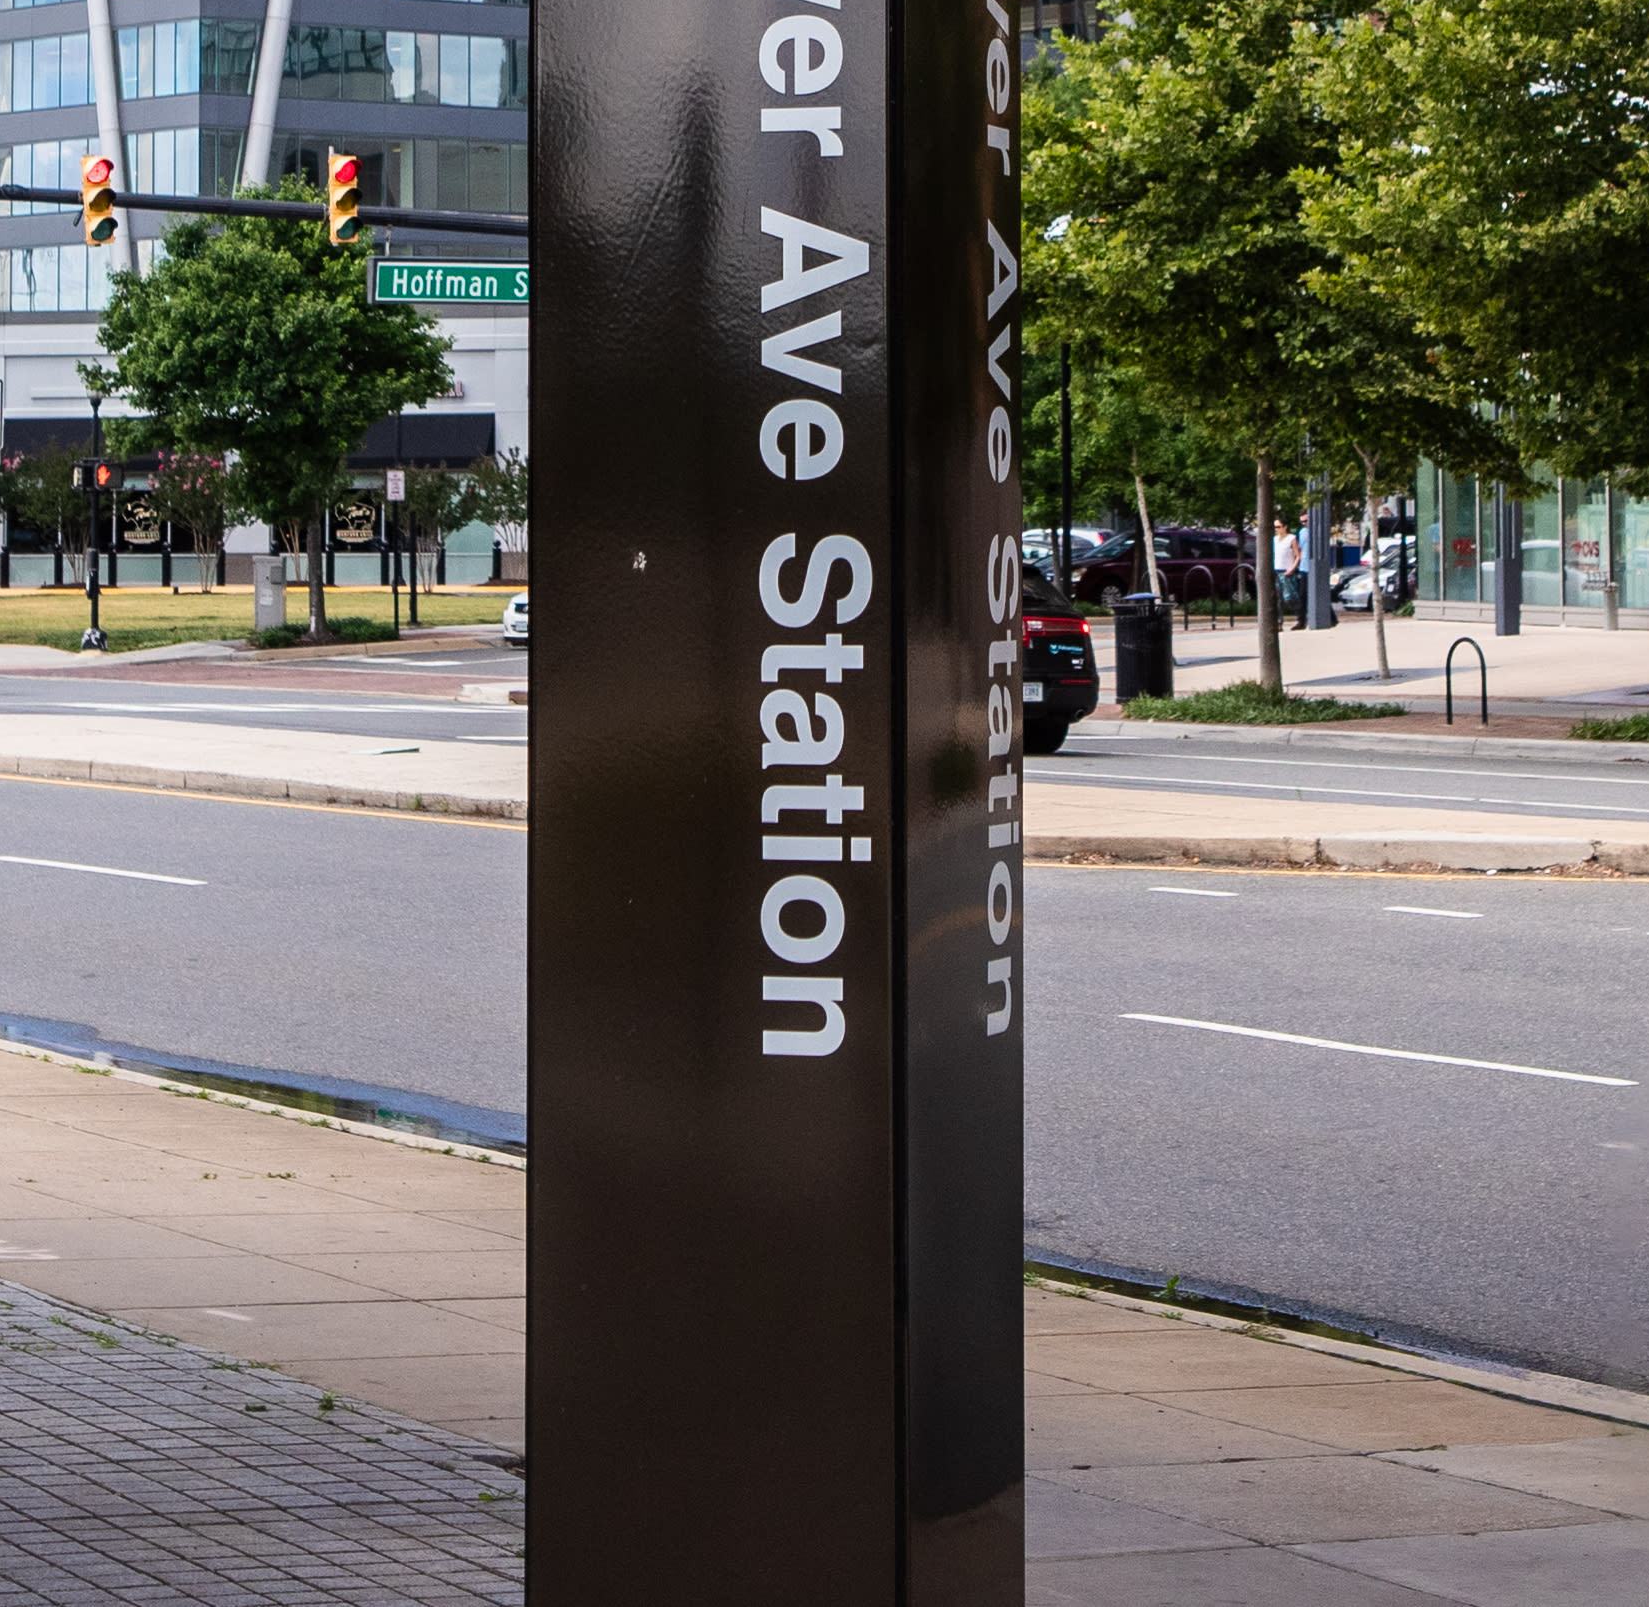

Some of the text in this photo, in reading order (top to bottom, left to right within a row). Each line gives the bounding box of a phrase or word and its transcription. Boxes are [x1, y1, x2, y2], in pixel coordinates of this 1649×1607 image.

[392, 268, 529, 298] Hoffman S
[759, 205, 870, 481] Ave
[987, 217, 1018, 484] Ave
[1583, 540, 1600, 557] CVS
[758, 532, 873, 1057] Station
[986, 533, 1020, 1037] Station
